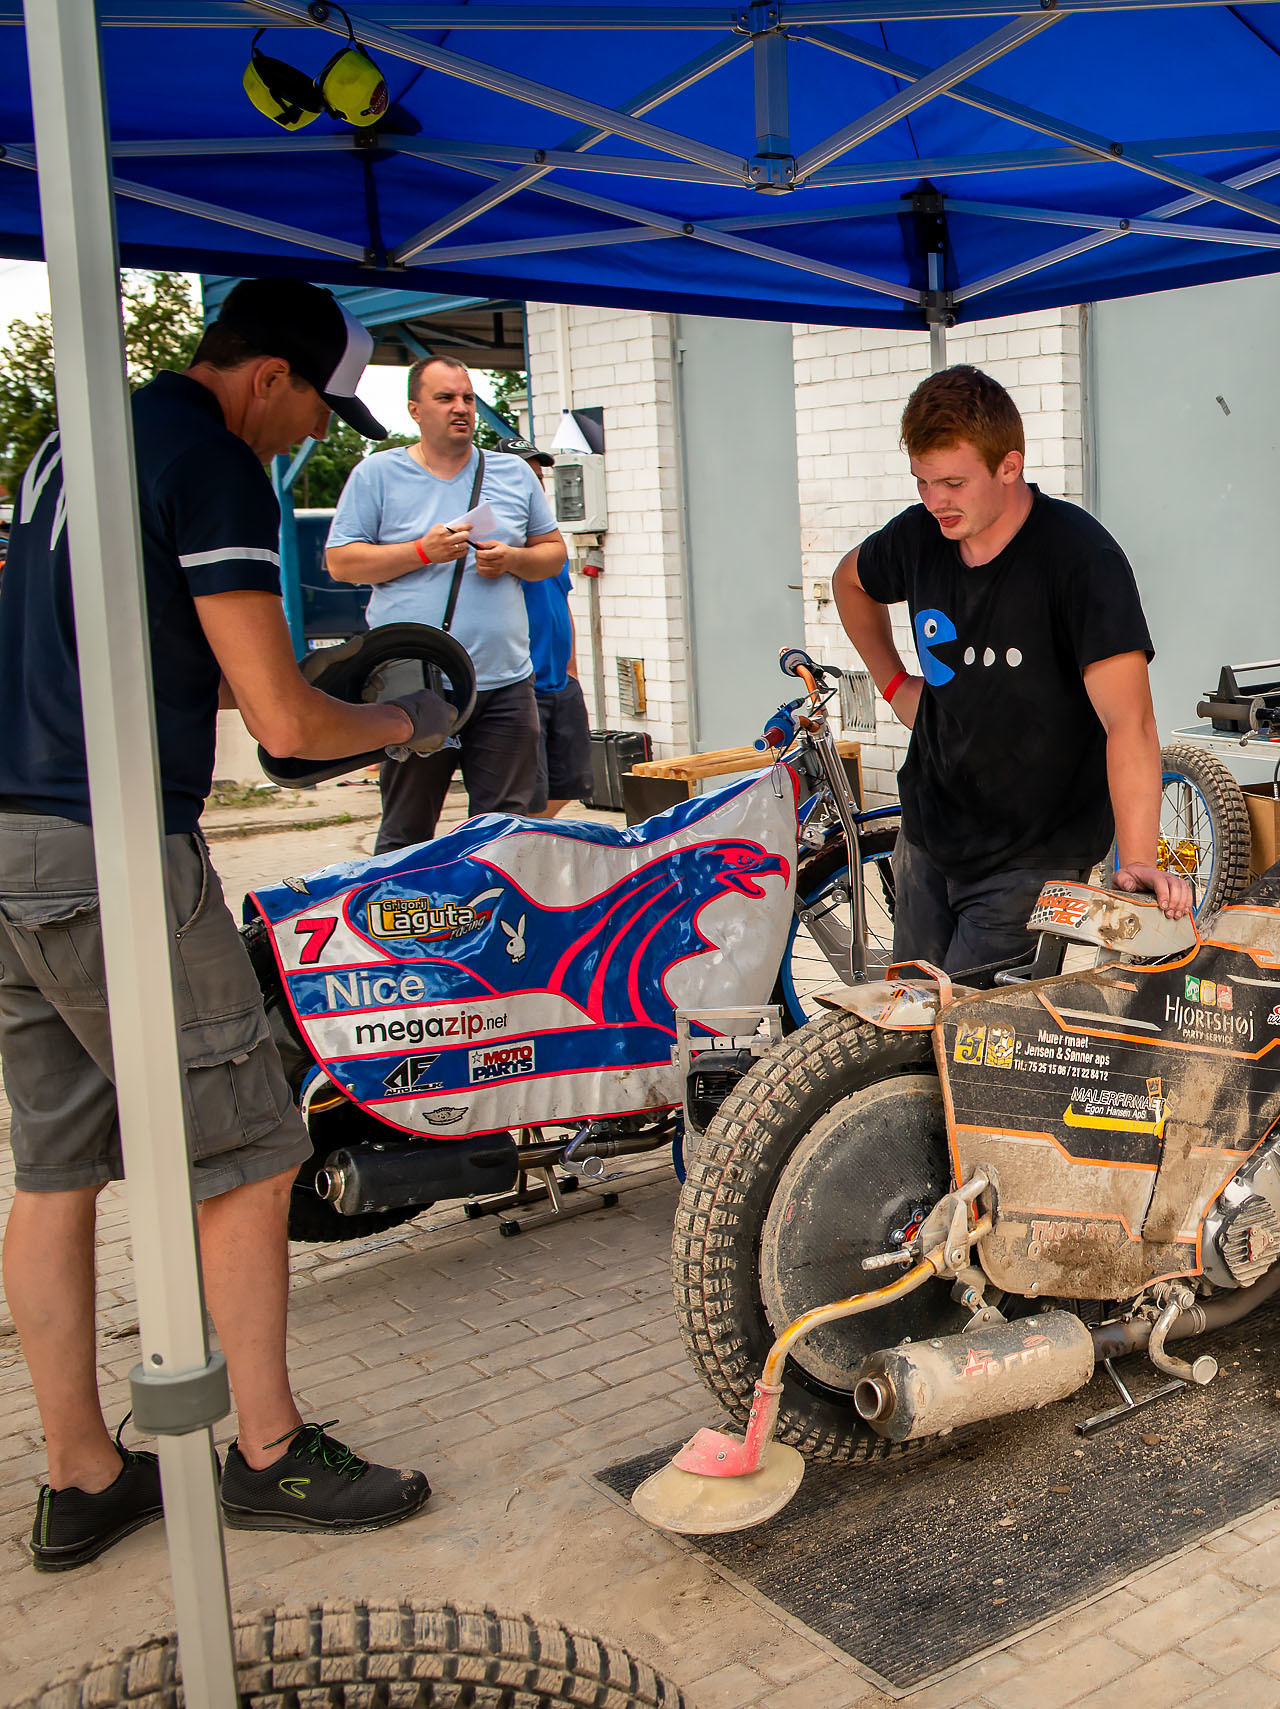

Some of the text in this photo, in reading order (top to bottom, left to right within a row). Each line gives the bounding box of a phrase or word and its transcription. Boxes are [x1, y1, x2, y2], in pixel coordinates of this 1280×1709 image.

[382, 898, 427, 912] Grigorij
[370, 902, 475, 937] Laguta
[1051, 909, 1082, 926] TEC
[294, 917, 339, 965] 7
[324, 970, 425, 1010] Nice
[356, 1010, 508, 1044] megazip.net
[1182, 1028, 1234, 1045] PARTY SERVICE
[483, 1045, 533, 1065] MOTO
[1015, 1041, 1110, 1067] P. Jensen & Sønner aps
[472, 1058, 533, 1082] PARTS
[1028, 1061, 1037, 1072] 75
[1038, 1062, 1047, 1073] 25
[1048, 1064, 1056, 1074] 15
[1072, 1067, 1080, 1078] 21
[1085, 1103, 1147, 1120] Egon Hansen ApS
